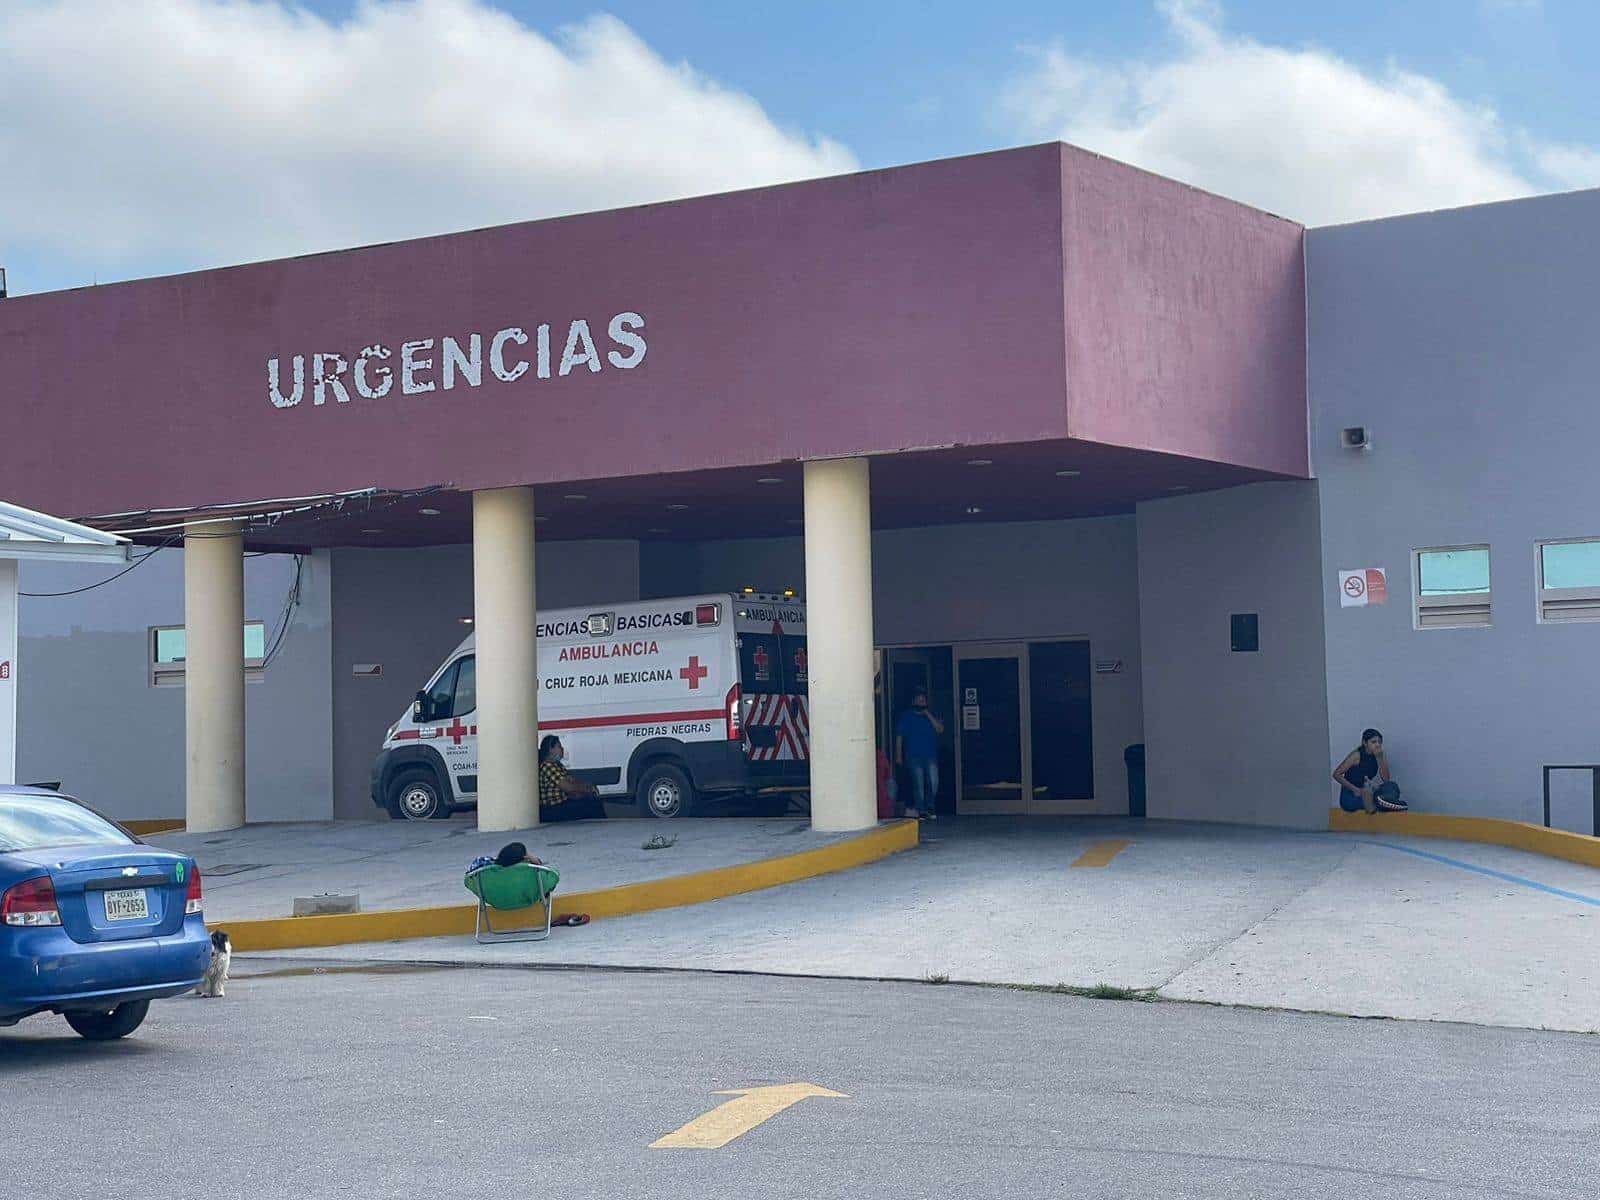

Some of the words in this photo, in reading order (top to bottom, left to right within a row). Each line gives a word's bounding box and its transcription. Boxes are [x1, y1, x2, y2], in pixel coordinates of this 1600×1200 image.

[268, 312, 647, 408] URGENCIAS
[536, 620, 589, 637] ENCIAS
[617, 612, 684, 630] BASICAS
[559, 640, 659, 662] AMBULANCIA
[545, 677, 575, 690] CRUZ
[579, 674, 609, 687] ROJA
[614, 669, 673, 685] MEXICANA
[626, 726, 667, 737] PIEDRAS
[671, 723, 711, 734] NEGRAS
